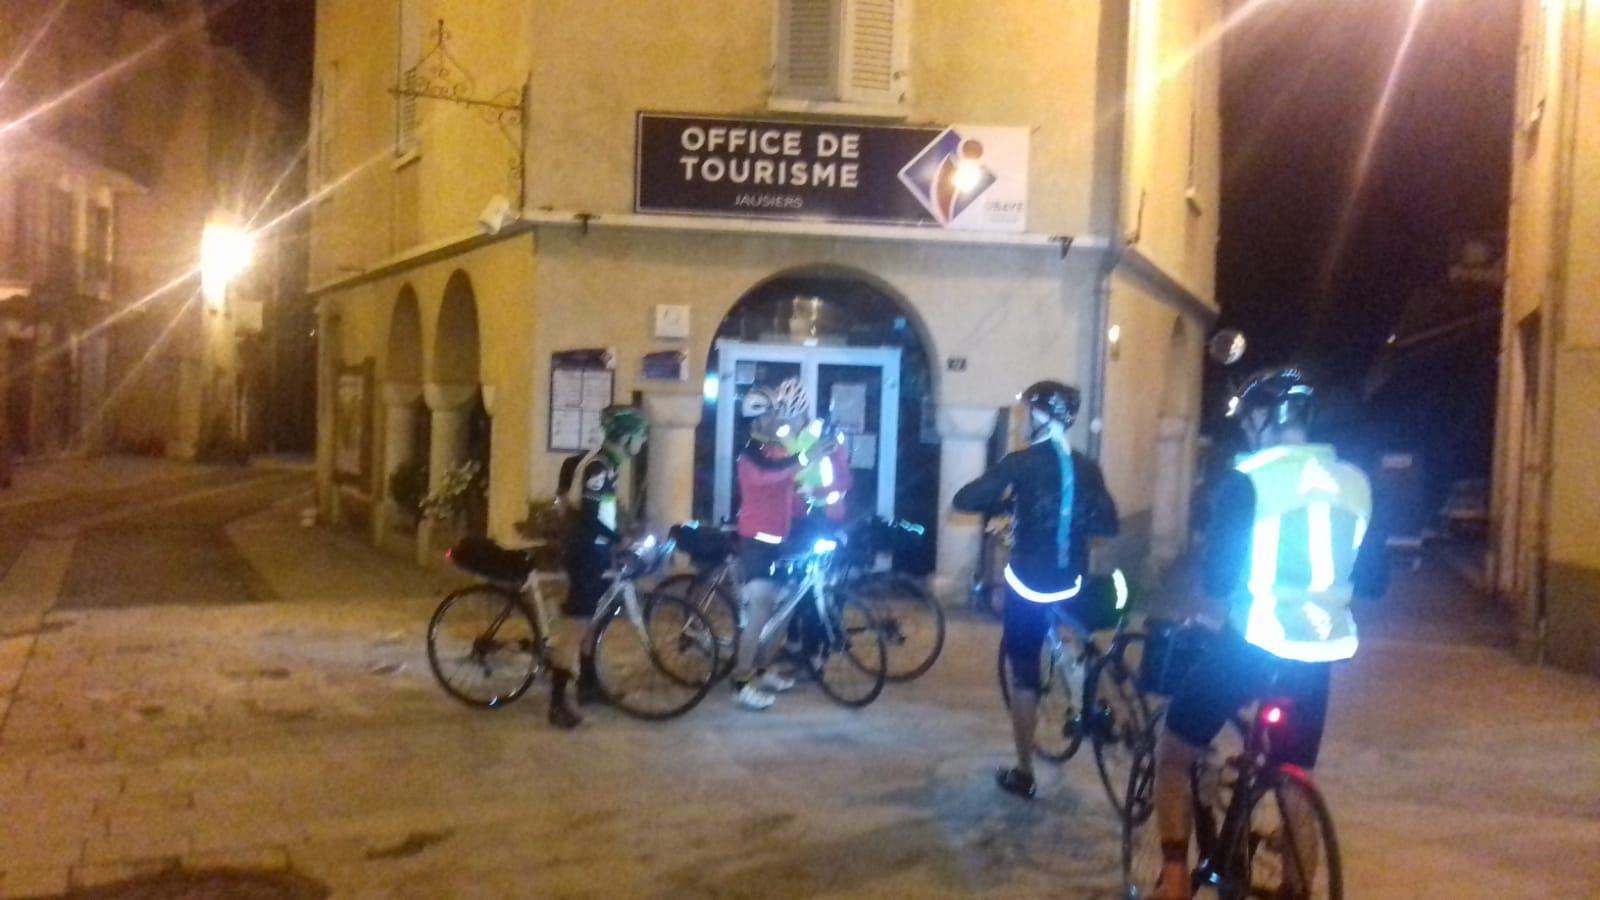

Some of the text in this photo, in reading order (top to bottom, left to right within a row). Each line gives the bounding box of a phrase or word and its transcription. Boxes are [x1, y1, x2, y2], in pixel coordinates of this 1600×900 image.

[681, 126, 860, 158] OFFICE DE
[680, 156, 860, 188] TOURISME
